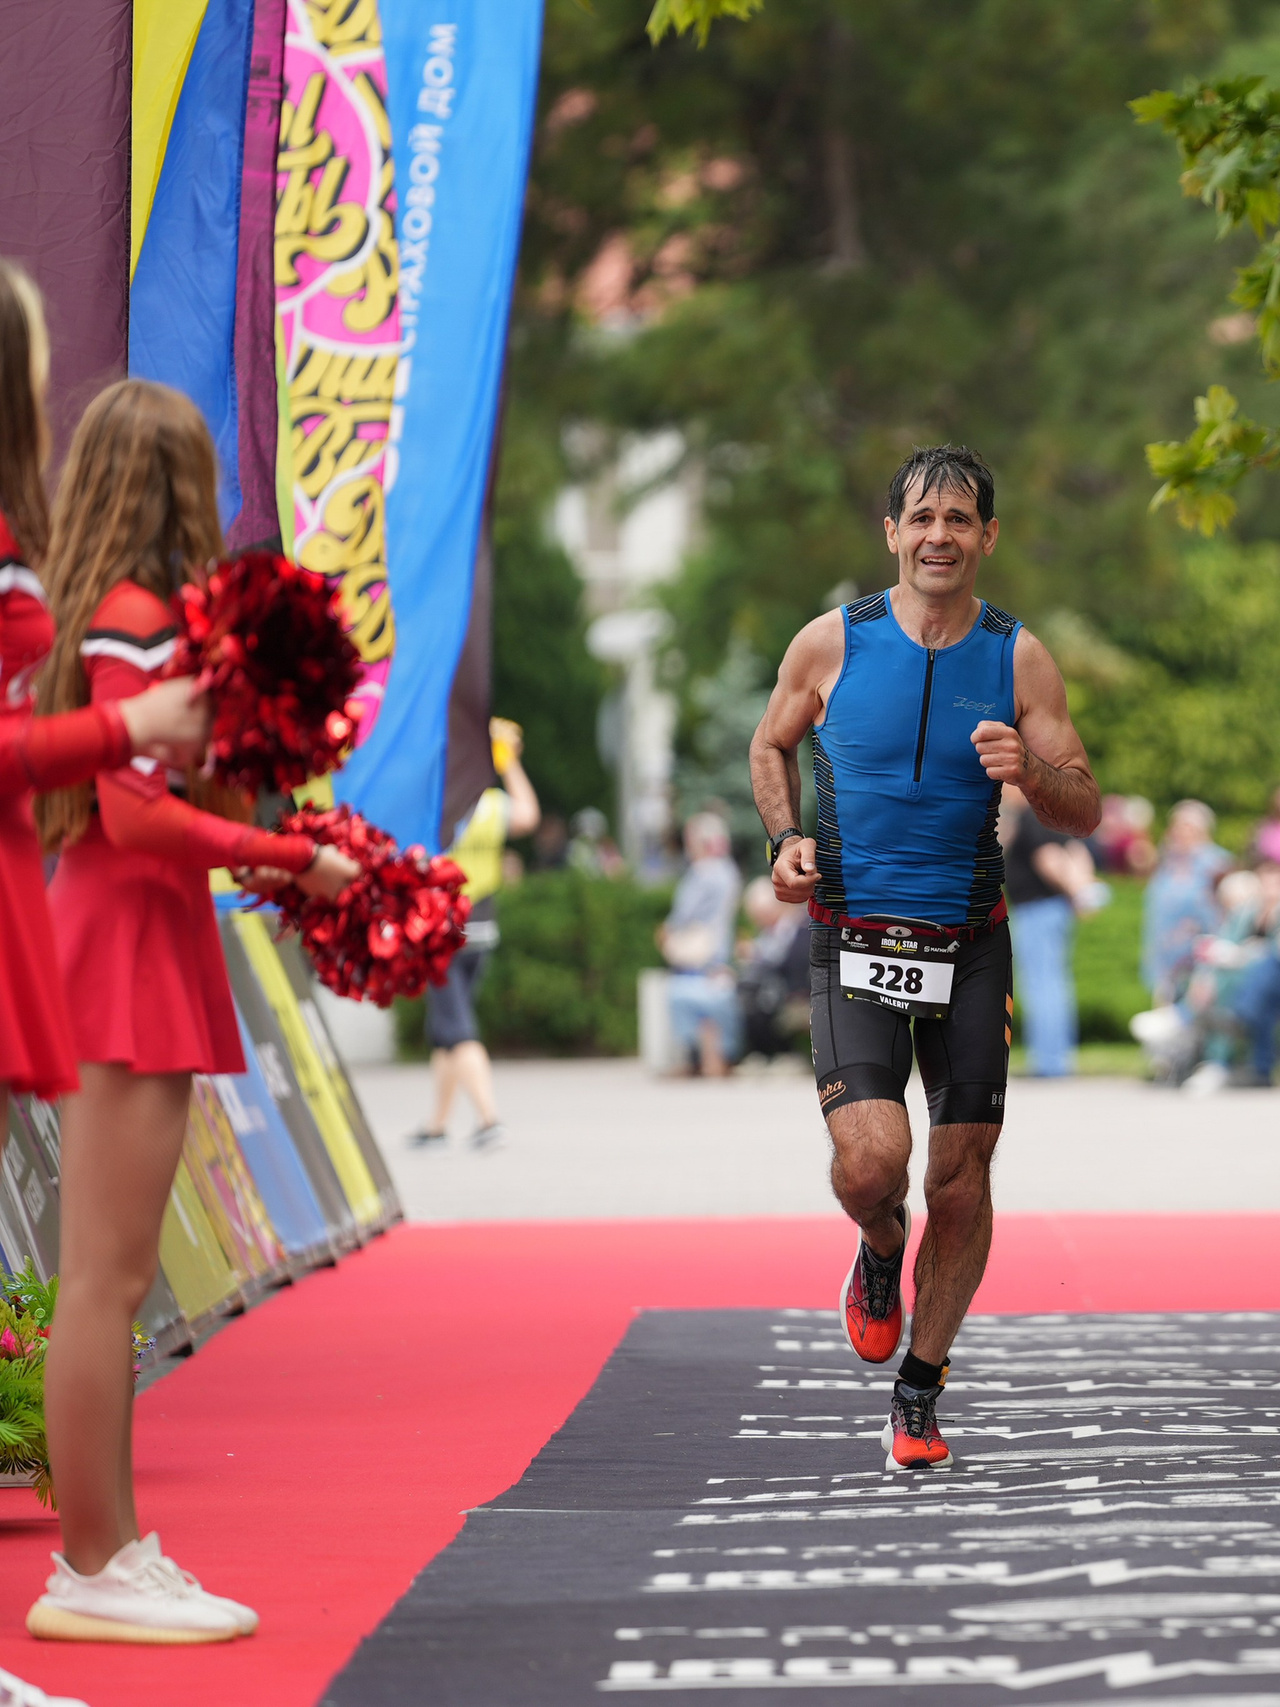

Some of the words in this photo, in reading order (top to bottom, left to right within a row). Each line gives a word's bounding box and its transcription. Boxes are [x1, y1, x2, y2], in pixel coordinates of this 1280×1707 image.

[416, 22, 457, 119] ДОМ
[881, 938, 897, 947] IRON
[902, 940, 919, 949] STAR
[869, 962, 924, 994] 228
[879, 995, 910, 1010] VALERIY
[698, 1481, 1000, 1503] IRON
[678, 1502, 998, 1524] IRON
[648, 1563, 1010, 1588] IRON
[606, 1656, 1020, 1688] IRON
